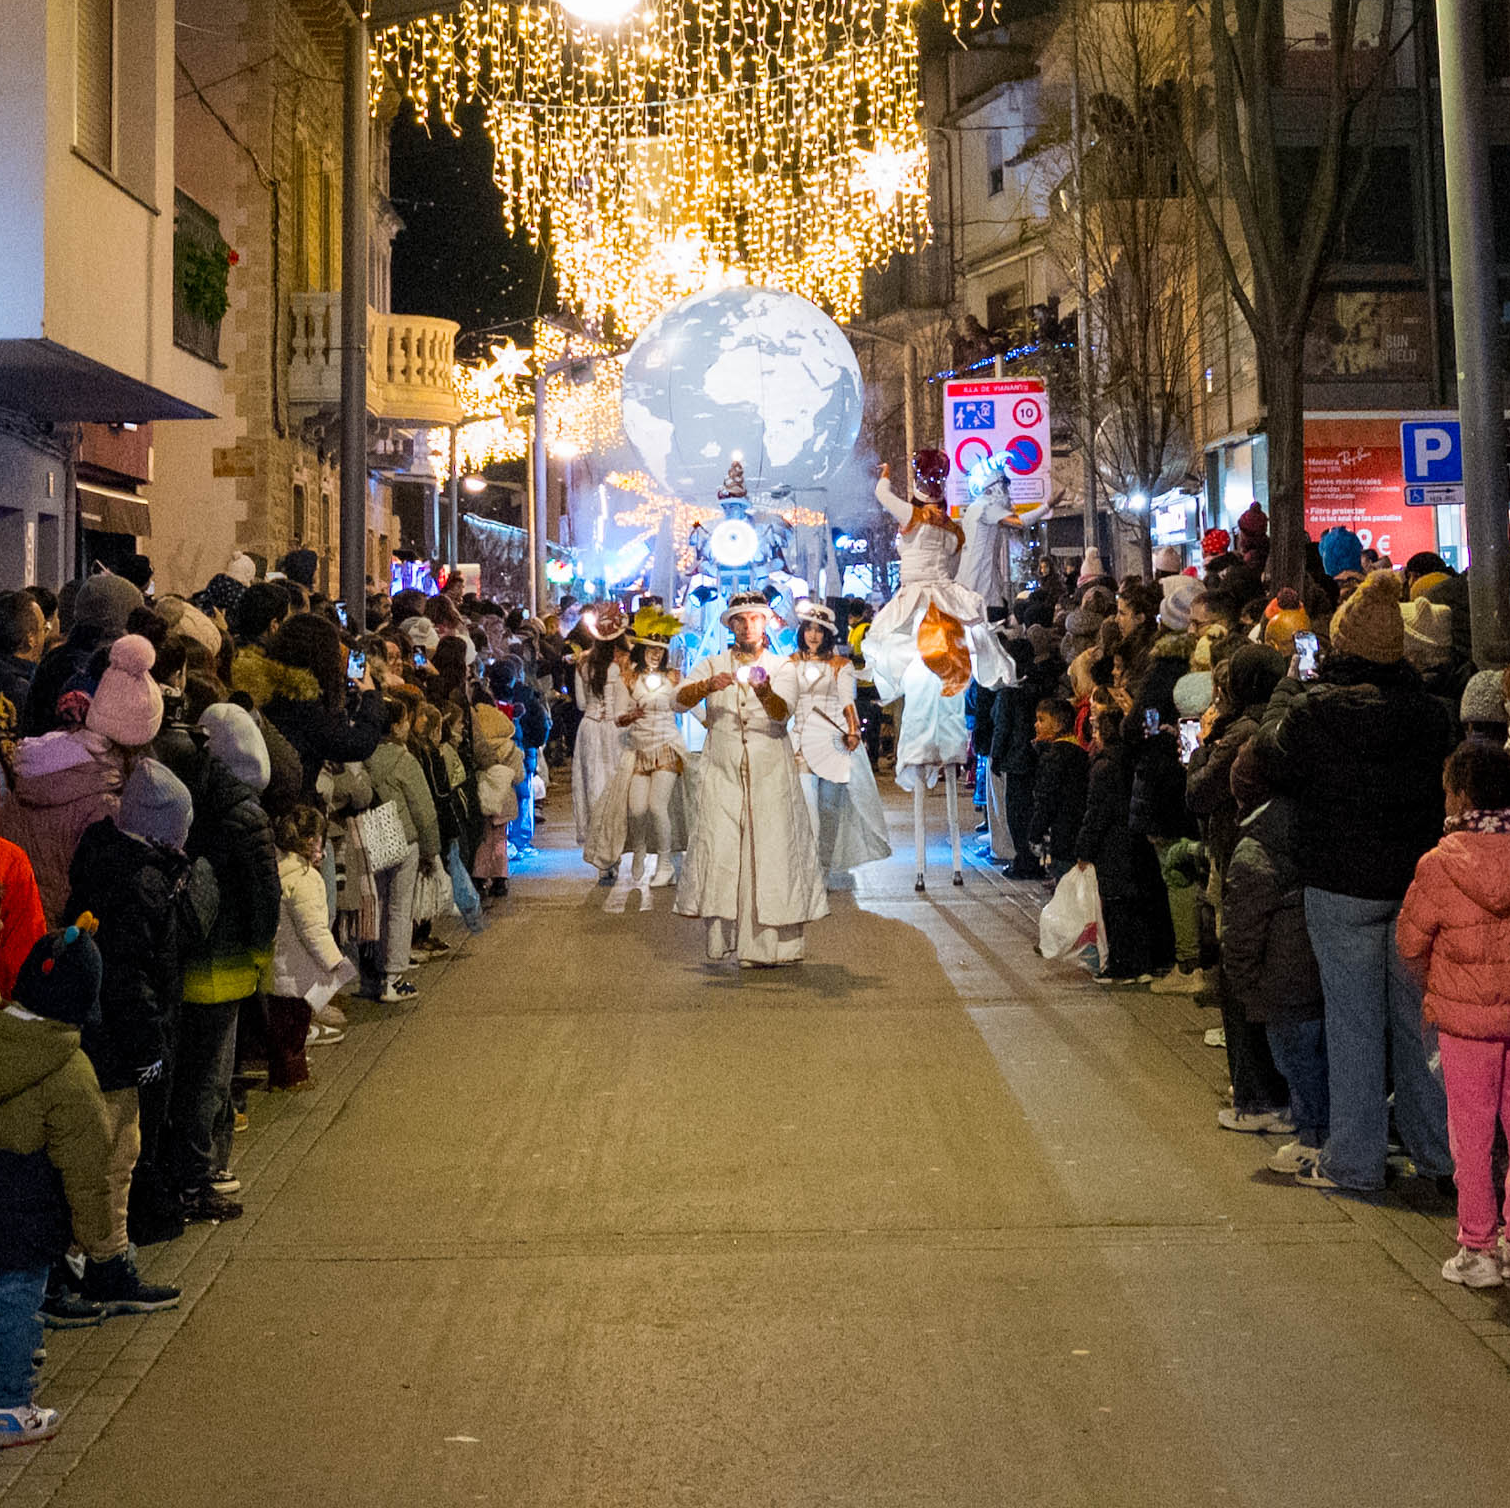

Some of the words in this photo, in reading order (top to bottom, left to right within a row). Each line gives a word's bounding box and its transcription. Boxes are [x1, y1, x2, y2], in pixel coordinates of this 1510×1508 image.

[1020, 408, 1034, 418] 10
[1413, 428, 1452, 477] P
[1308, 478, 1335, 486] Lentes
[1310, 507, 1331, 515] Filtro
[1331, 507, 1366, 516] protector
